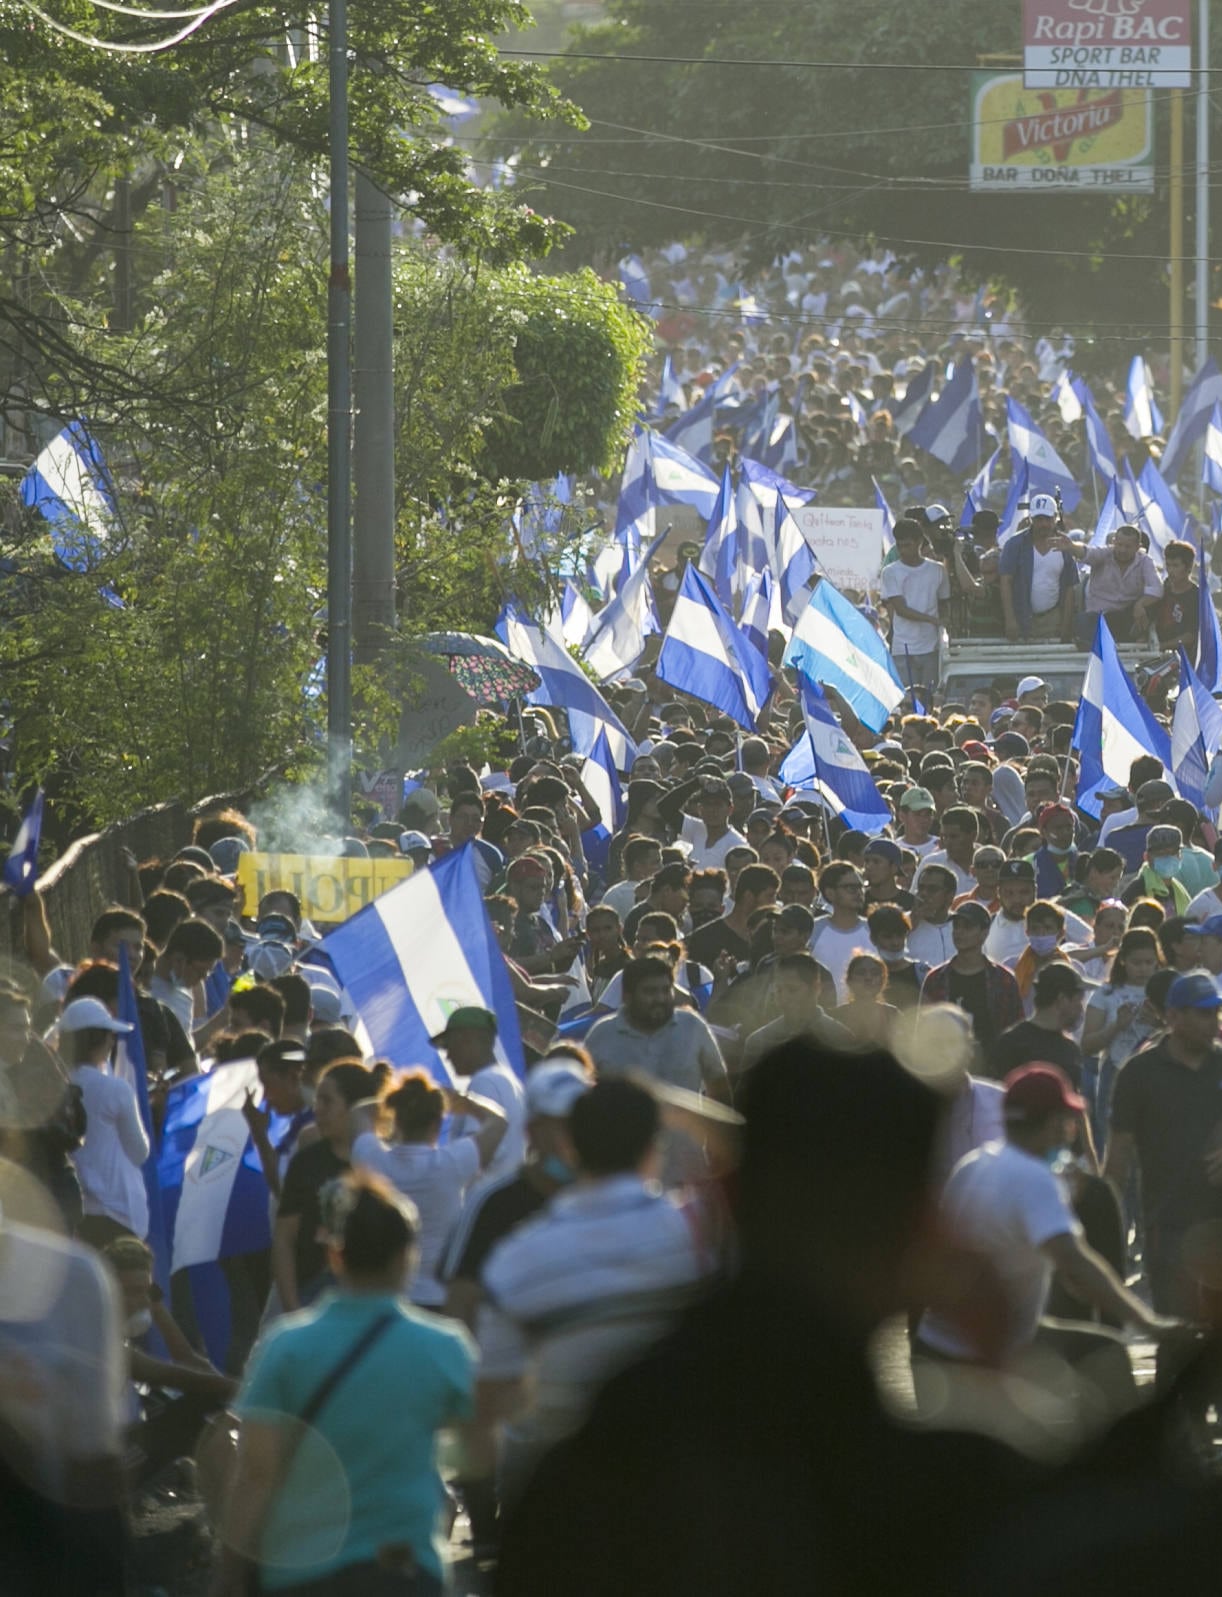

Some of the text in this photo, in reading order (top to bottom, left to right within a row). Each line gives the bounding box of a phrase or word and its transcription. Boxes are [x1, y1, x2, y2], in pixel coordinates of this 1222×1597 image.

[1034, 15, 1184, 46] Rapi BAC
[1049, 47, 1161, 65] SPORT BAR
[1108, 70, 1156, 87] THEL
[1016, 105, 1111, 146] Victoria
[983, 167, 1017, 182] BAR
[1032, 165, 1080, 183] DOÑA
